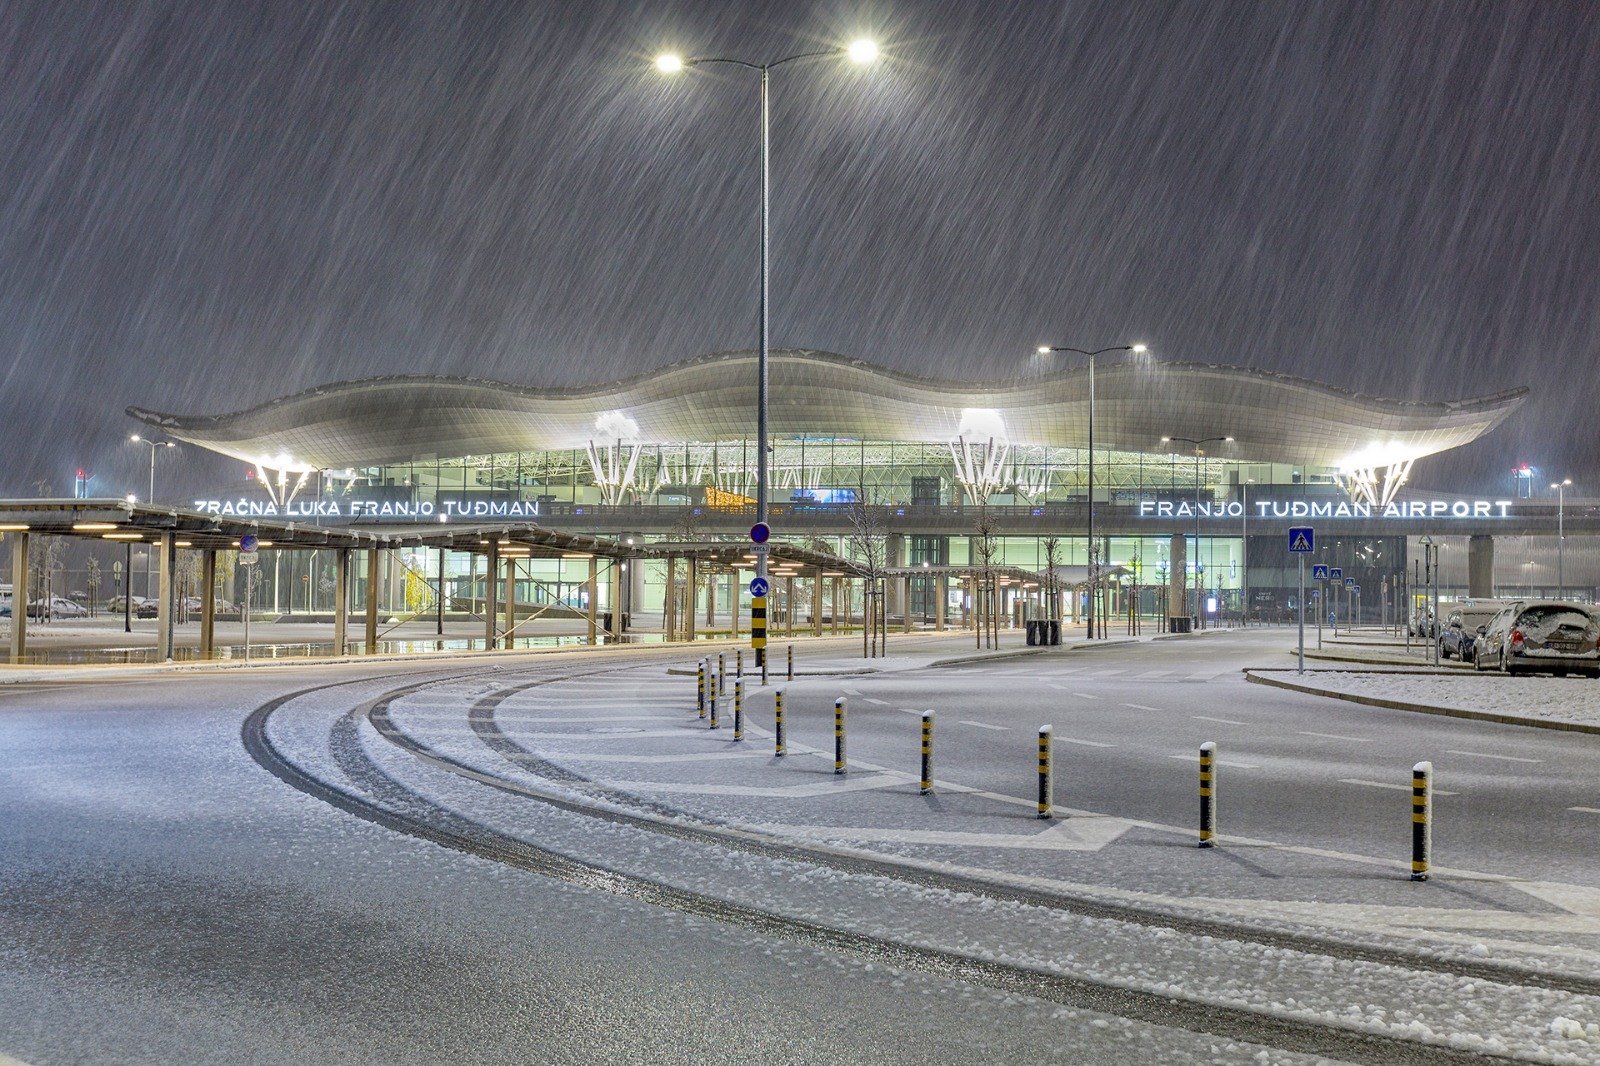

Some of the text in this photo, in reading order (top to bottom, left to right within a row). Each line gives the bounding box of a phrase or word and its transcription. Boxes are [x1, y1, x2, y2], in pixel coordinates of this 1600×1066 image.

[287, 500, 340, 515] LUKA
[350, 501, 433, 515] FRANJO
[443, 501, 539, 515] TUĐMAN
[1140, 501, 1512, 517] FRANJO TUĐMAN AIRPORT
